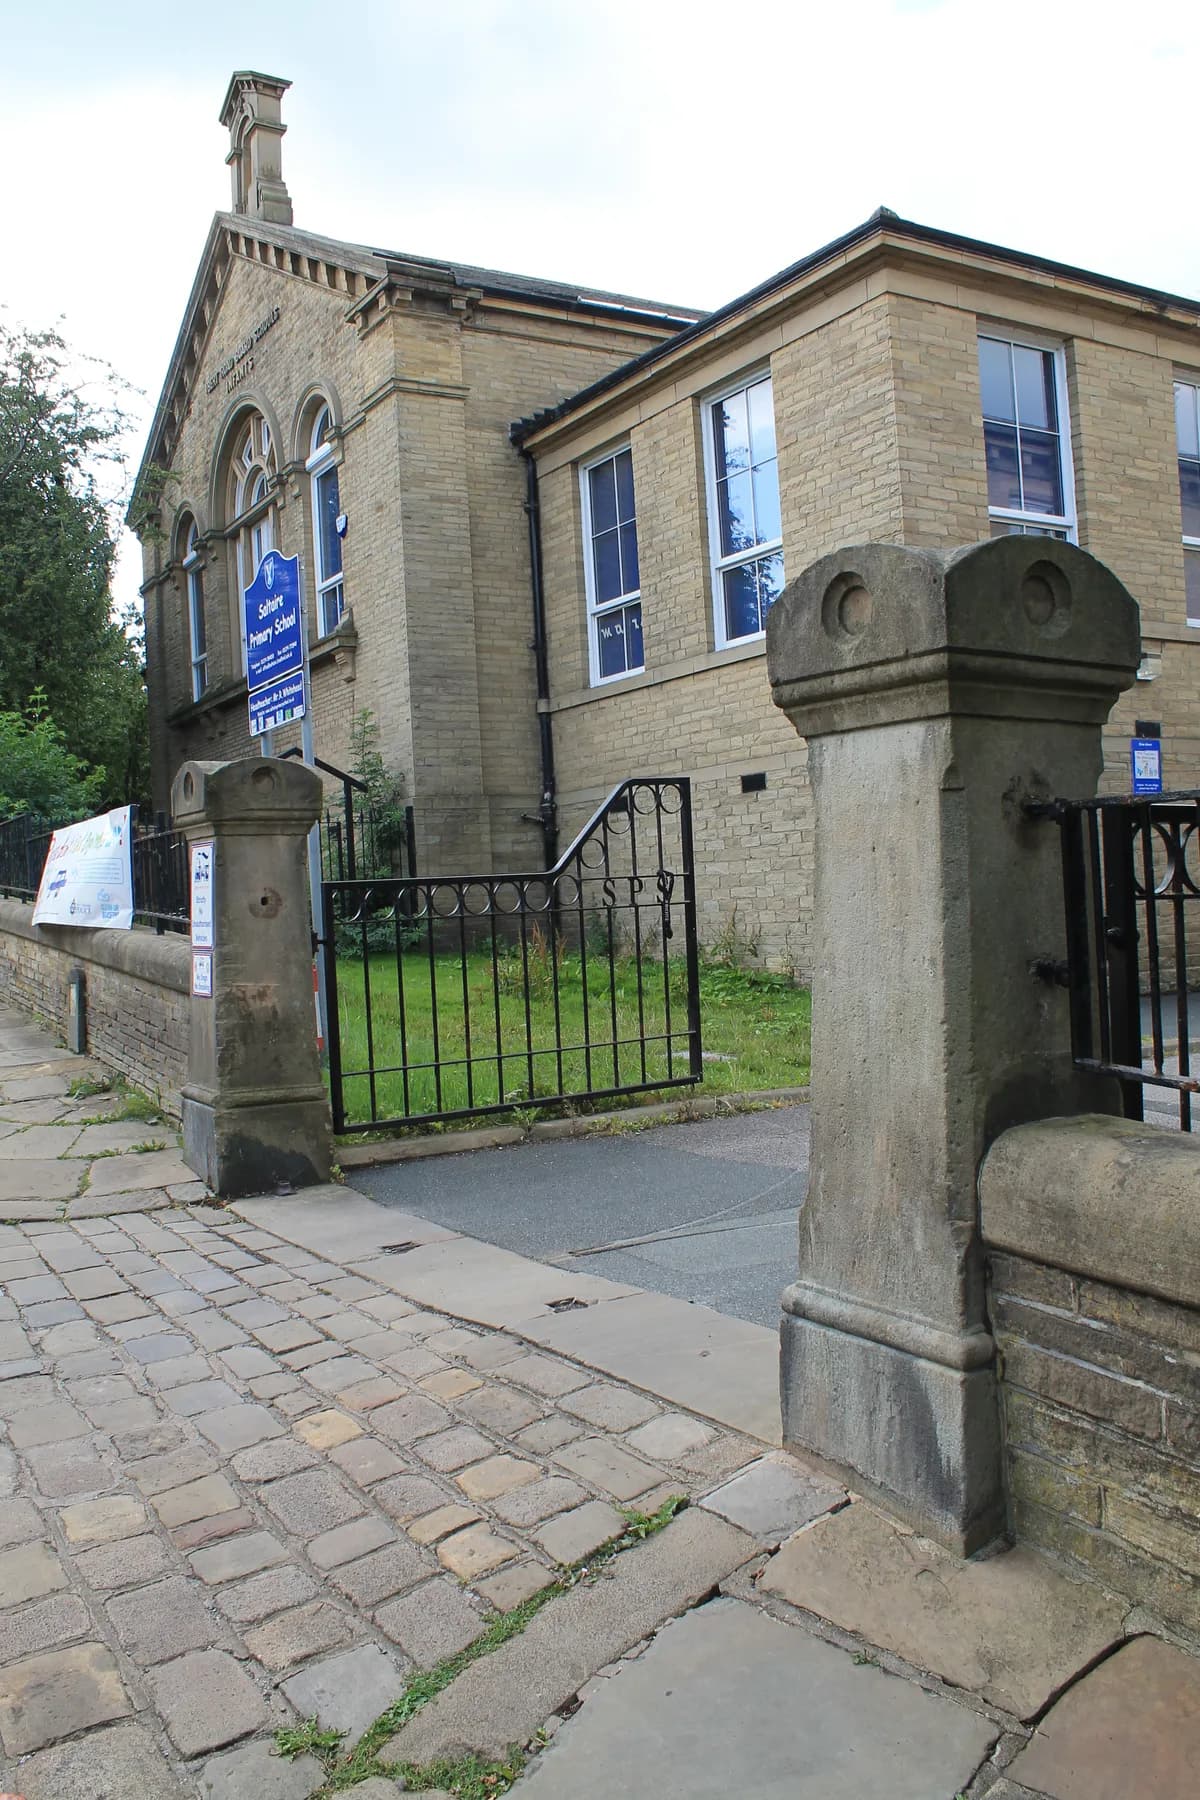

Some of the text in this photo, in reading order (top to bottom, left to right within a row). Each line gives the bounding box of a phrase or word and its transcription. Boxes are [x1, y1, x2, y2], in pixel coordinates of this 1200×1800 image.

[258, 594, 284, 620] Saltaire
[249, 607, 296, 650] Primary School
